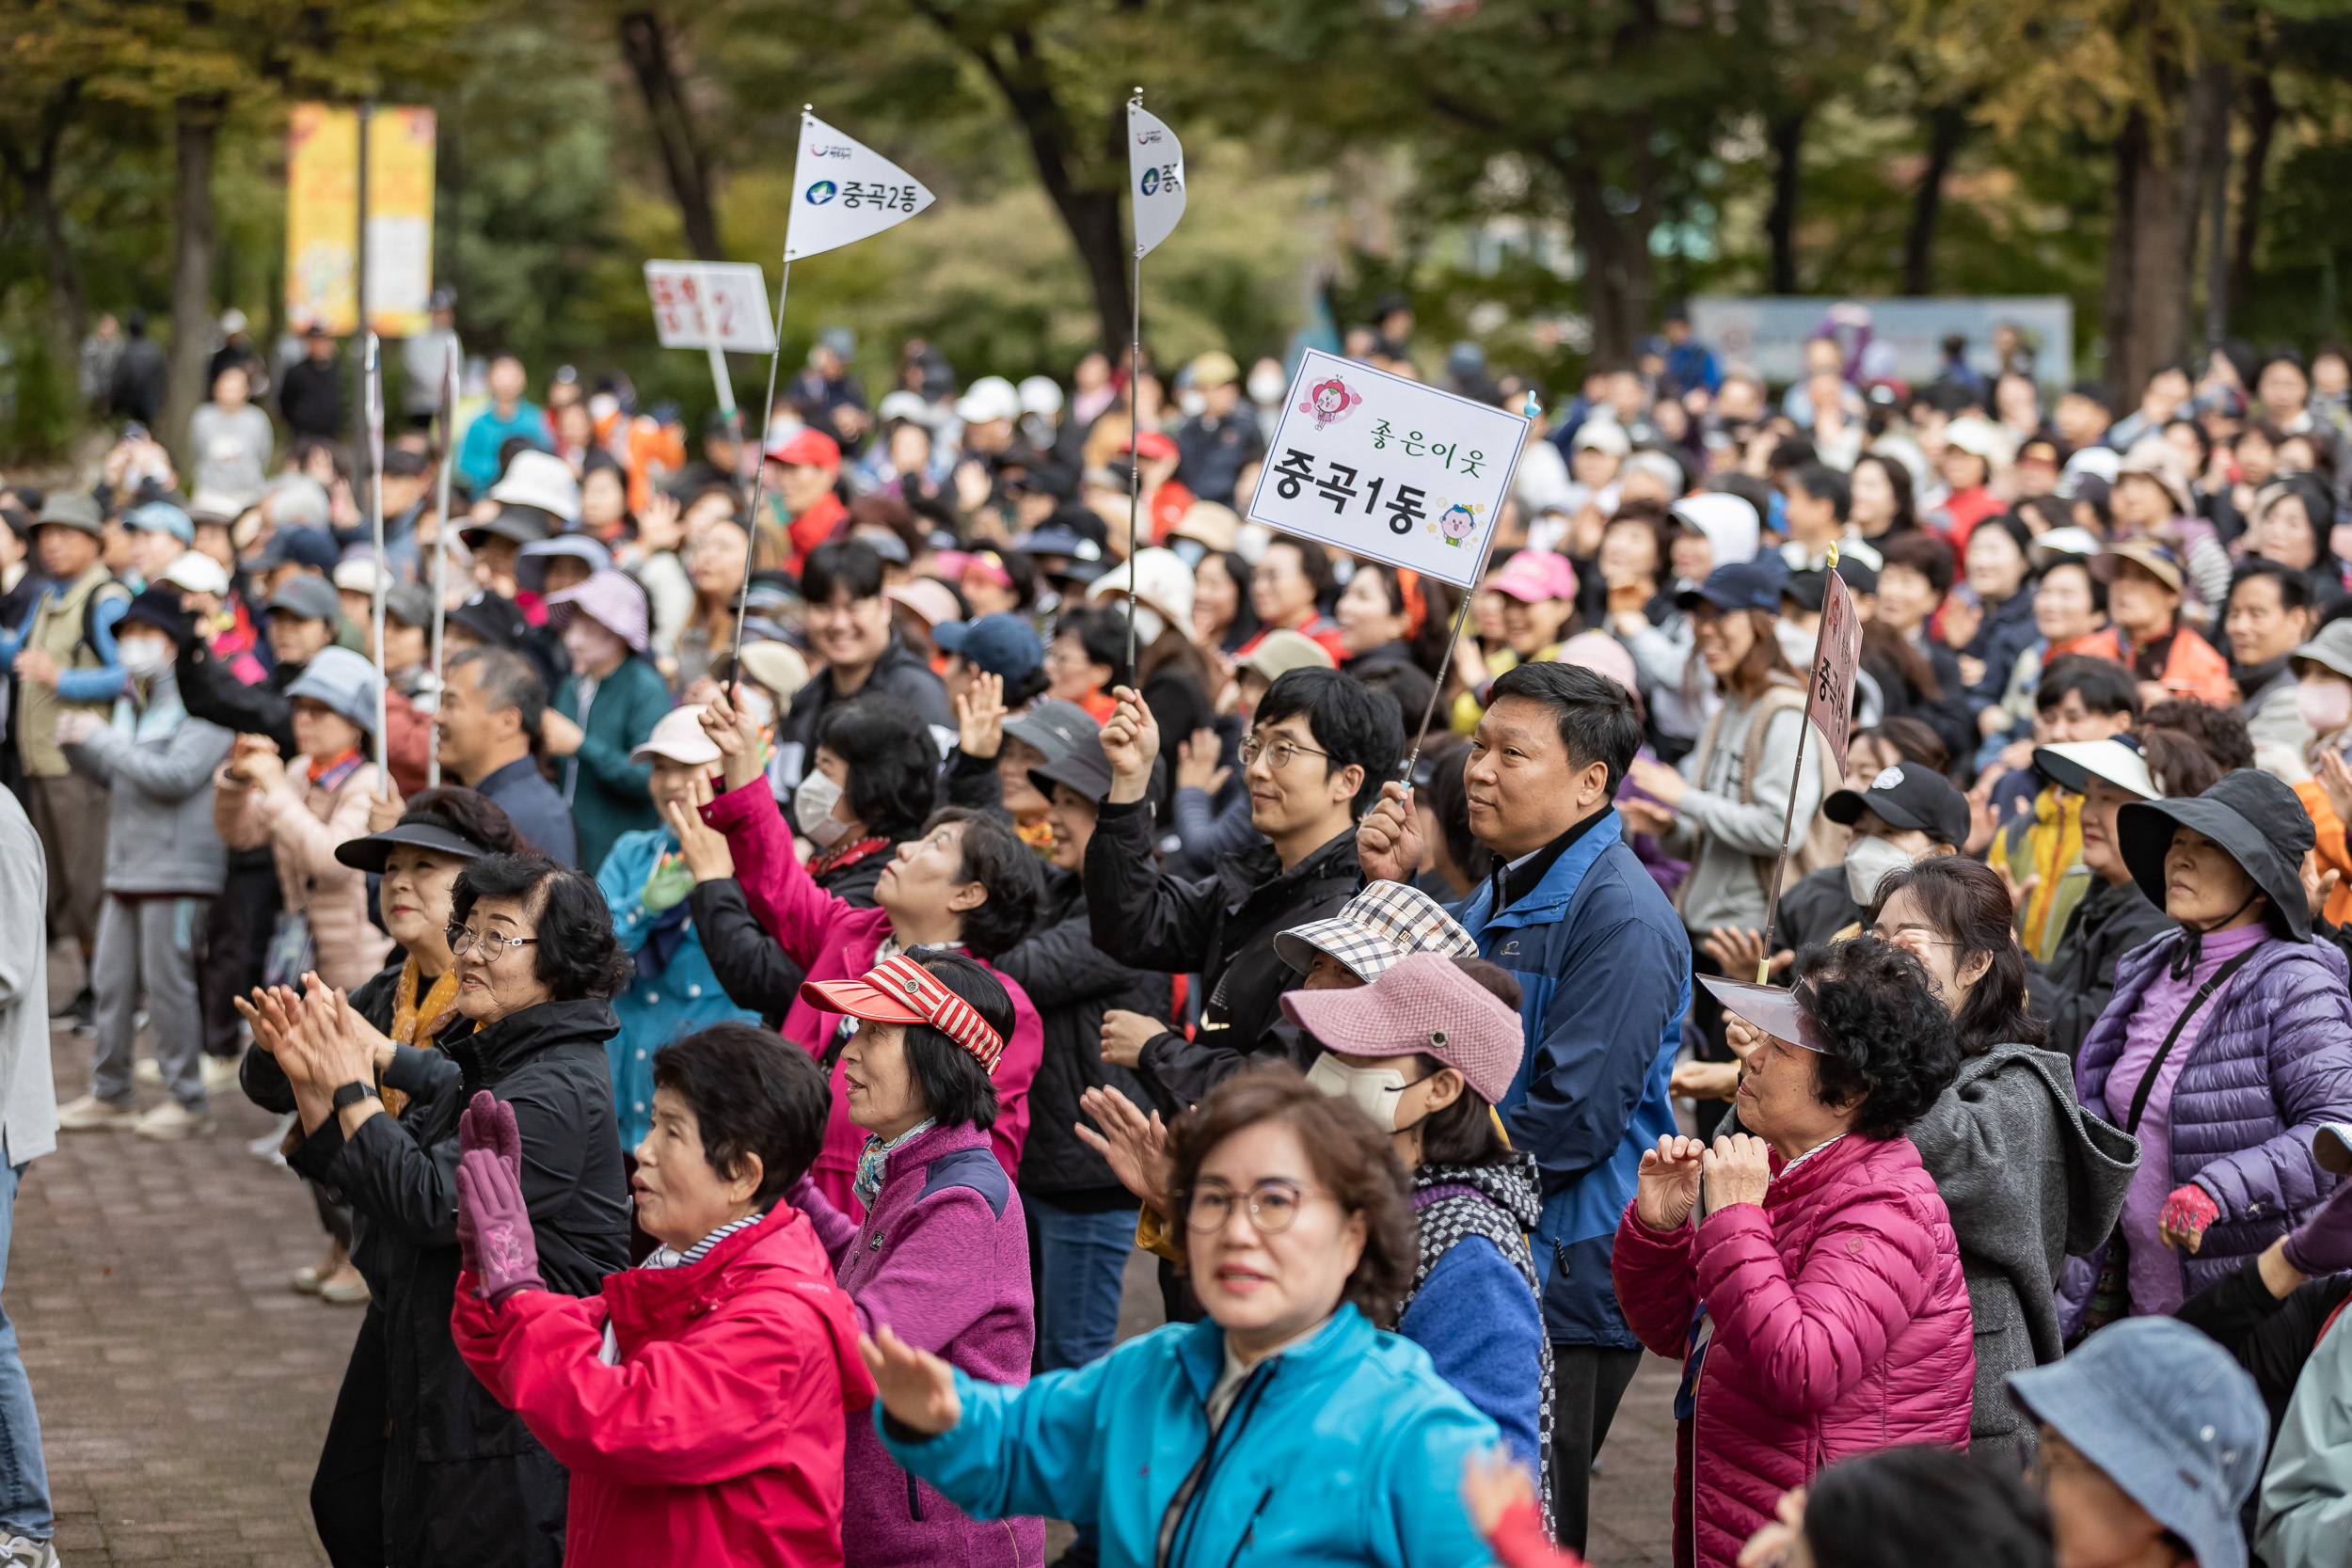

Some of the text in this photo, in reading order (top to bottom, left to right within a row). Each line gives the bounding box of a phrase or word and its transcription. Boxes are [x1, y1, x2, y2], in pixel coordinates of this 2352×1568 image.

[842, 182, 916, 213] 중곡2동
[1371, 418, 1487, 479] 좋은이웃
[1273, 448, 1427, 534] 중곡1동
